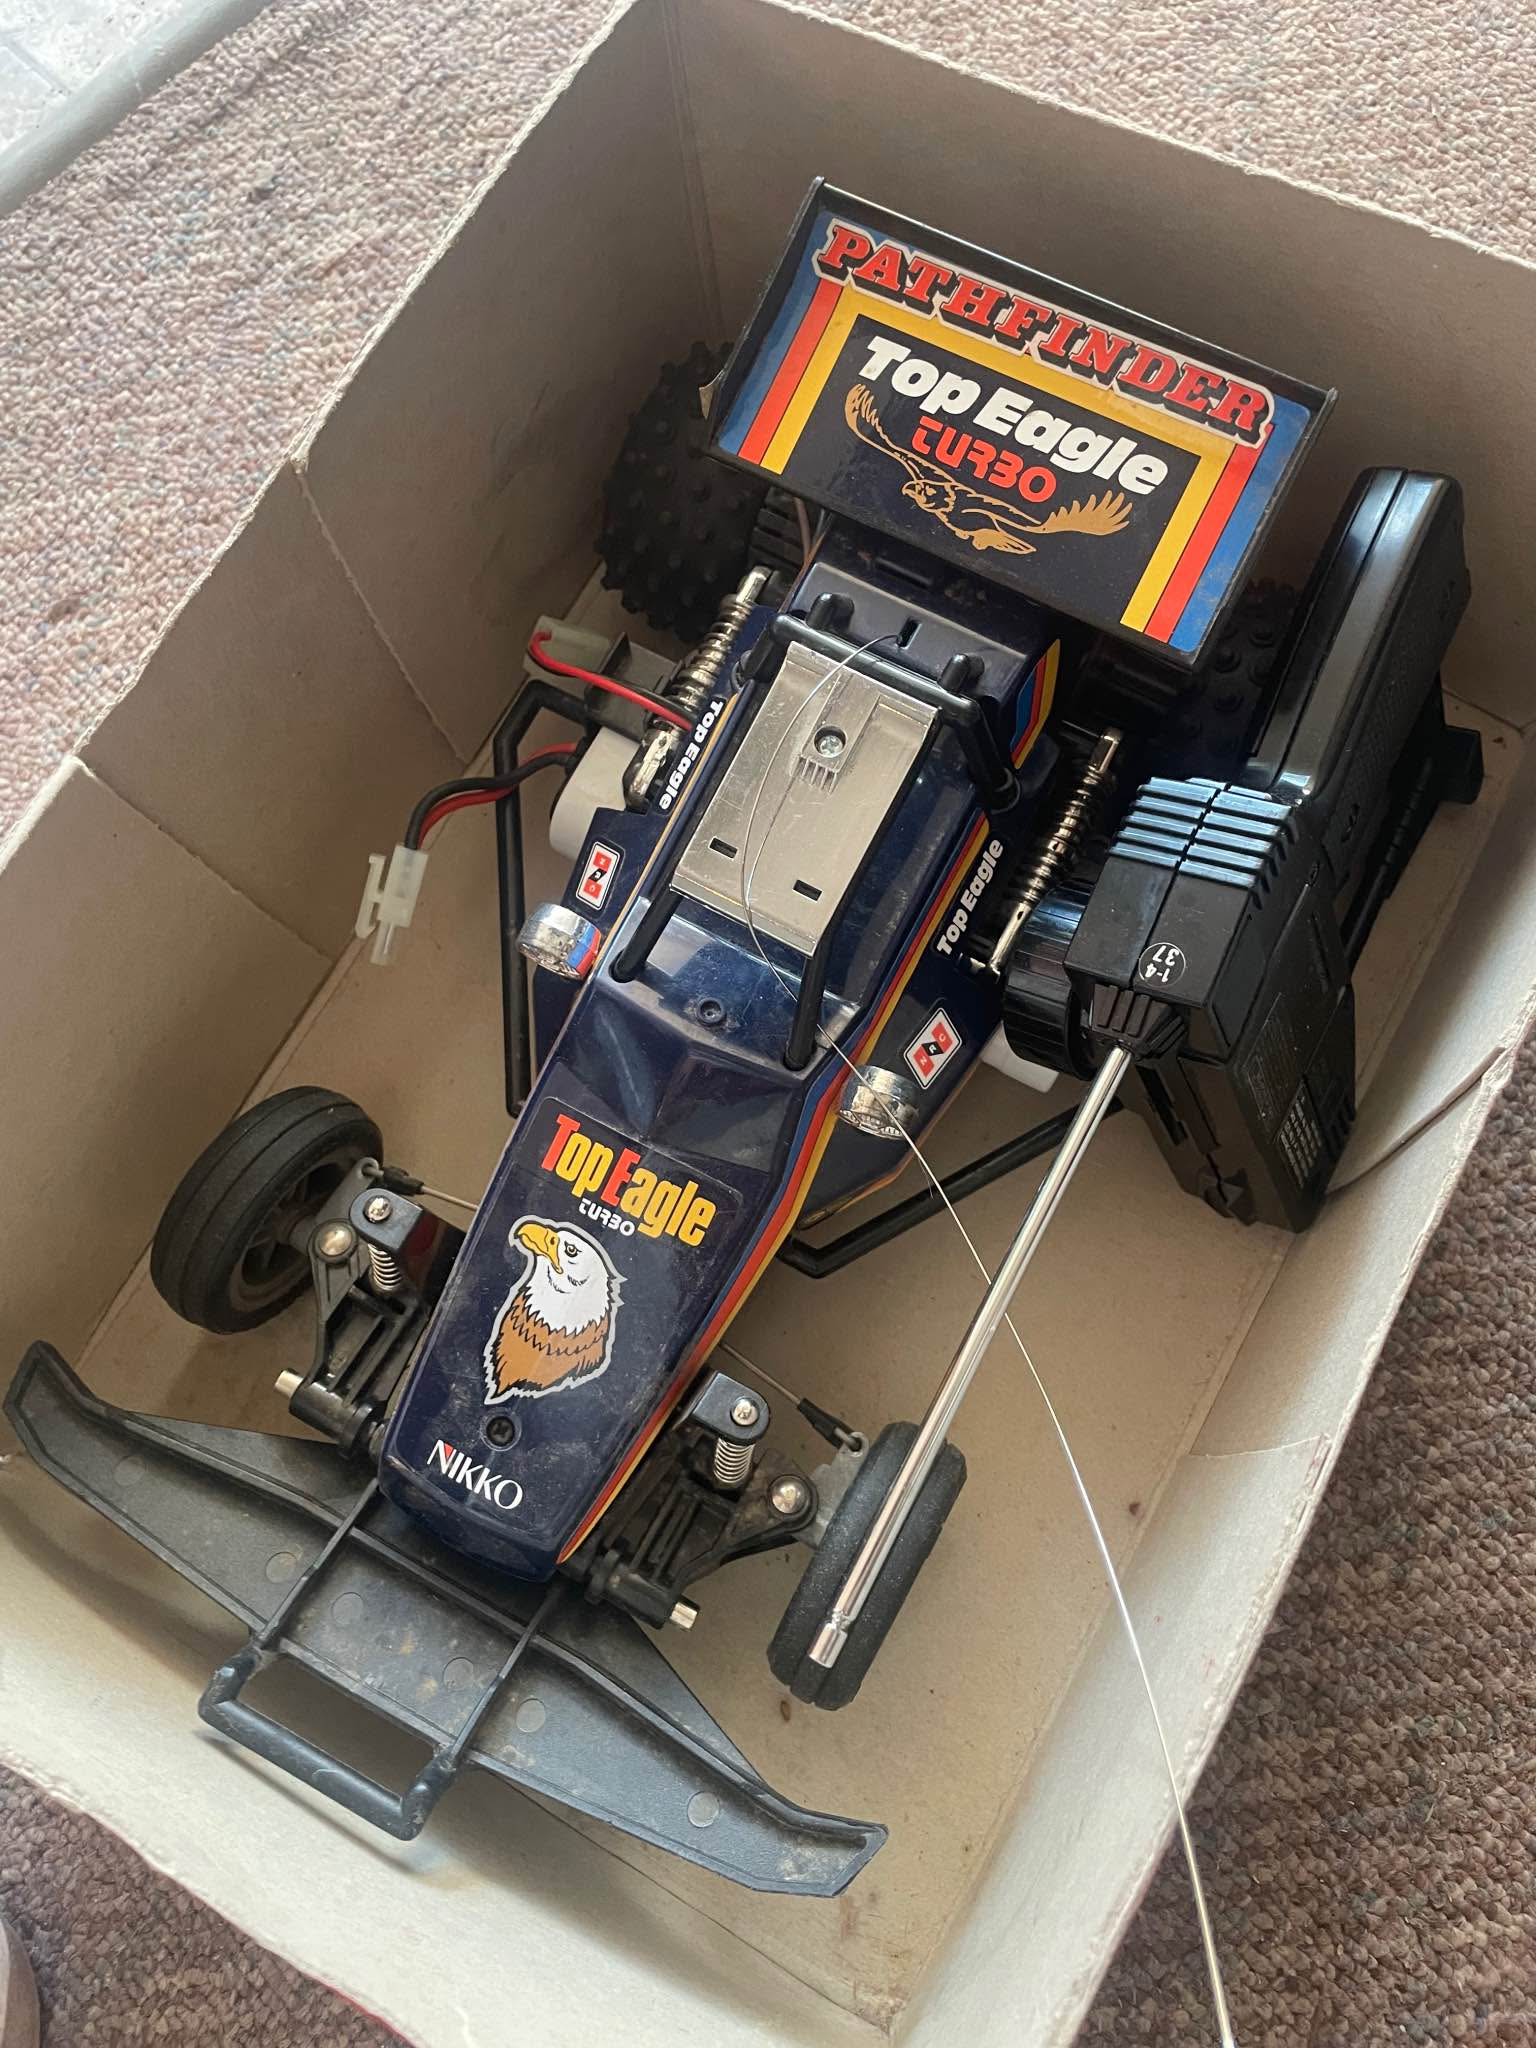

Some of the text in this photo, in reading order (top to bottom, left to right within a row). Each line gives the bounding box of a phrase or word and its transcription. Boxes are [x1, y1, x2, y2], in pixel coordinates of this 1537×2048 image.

[820, 224, 1272, 443] PATHFINDER
[857, 336, 1168, 495] Top Eagle
[659, 701, 724, 810] Top Eagle
[937, 839, 1004, 956] Top Eagle
[426, 1439, 524, 1510] NIKKO
